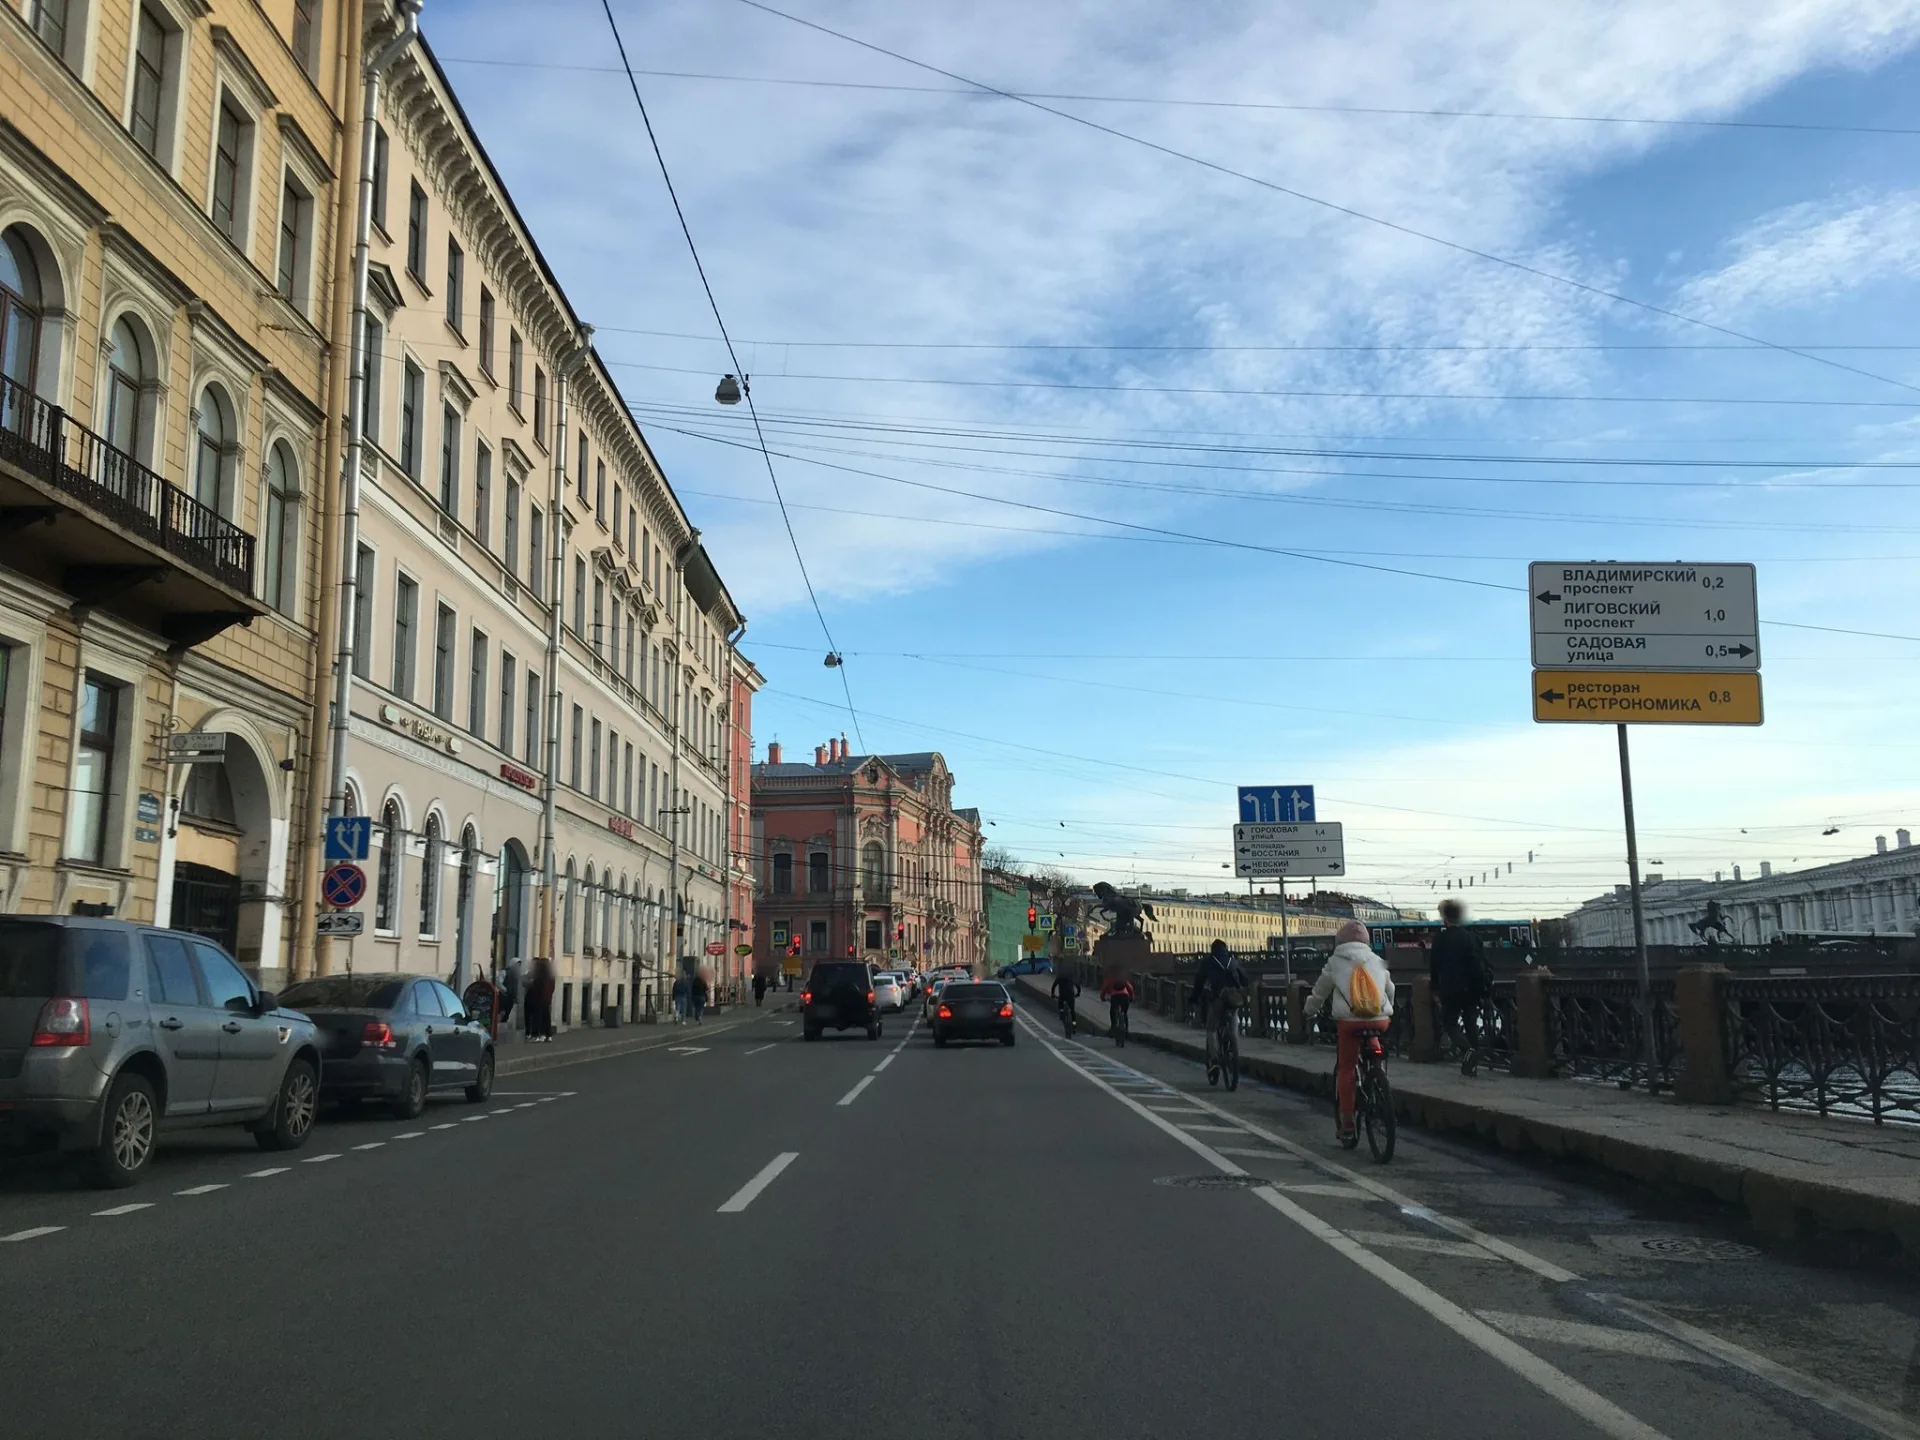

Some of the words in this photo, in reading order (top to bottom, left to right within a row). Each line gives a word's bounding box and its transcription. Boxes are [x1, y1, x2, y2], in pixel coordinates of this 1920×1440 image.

[1563, 568, 1697, 583] ВЛАДИМИРСКИЙ
[1563, 584, 1634, 596] проспект
[1702, 577, 1725, 590] 0,2
[1564, 600, 1661, 615] ЛИГОВСКИЙ
[1704, 609, 1726, 623] 1,0
[1564, 618, 1635, 630] проспект
[1567, 636, 1646, 650] САДОВАЯ
[1567, 651, 1614, 663] улица
[1705, 645, 1728, 658] 0,5
[1567, 682, 1640, 694] ресторан
[1568, 697, 1702, 711] ГАСТРОНОМИКА
[1709, 691, 1731, 704] 0,8
